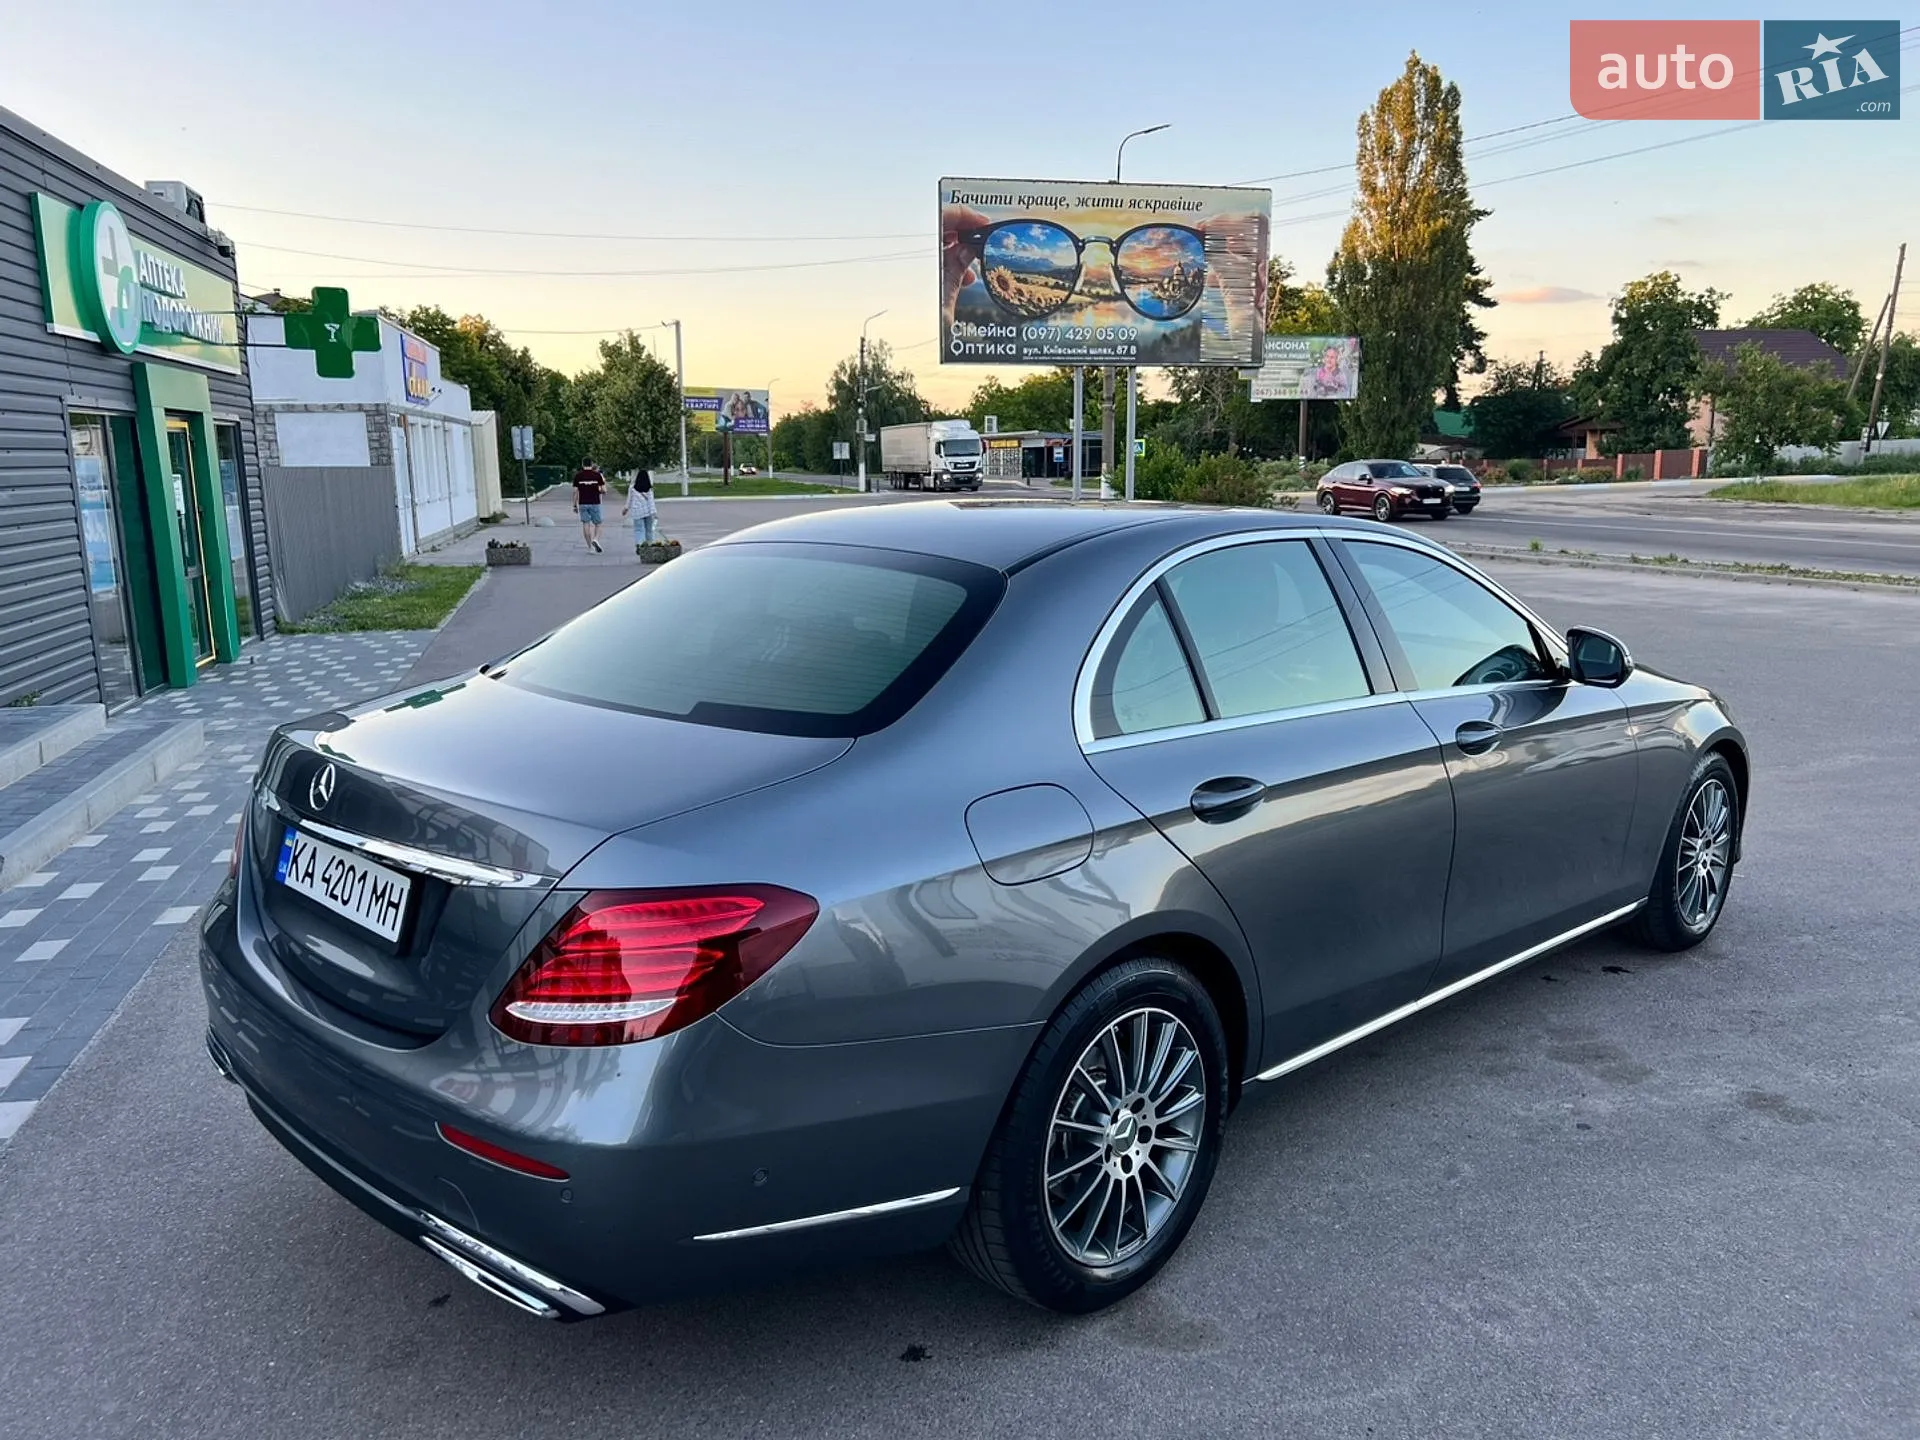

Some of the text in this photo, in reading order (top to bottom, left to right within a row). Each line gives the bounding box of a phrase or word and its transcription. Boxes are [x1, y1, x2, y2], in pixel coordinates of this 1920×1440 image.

[951, 189, 1204, 213] Бачити краще, жити яскравіше
[140, 250, 188, 299] АПТЕКА
[141, 289, 224, 344] ПОДОРОЖНИК
[951, 320, 1017, 337] Сімейна
[1022, 326, 1138, 341] (097) 429 05 09
[951, 340, 1017, 356] Оптика
[1022, 347, 1041, 355] вул.
[1043, 345, 1087, 354] Київський
[288, 838, 404, 931] KA 4201 MH
